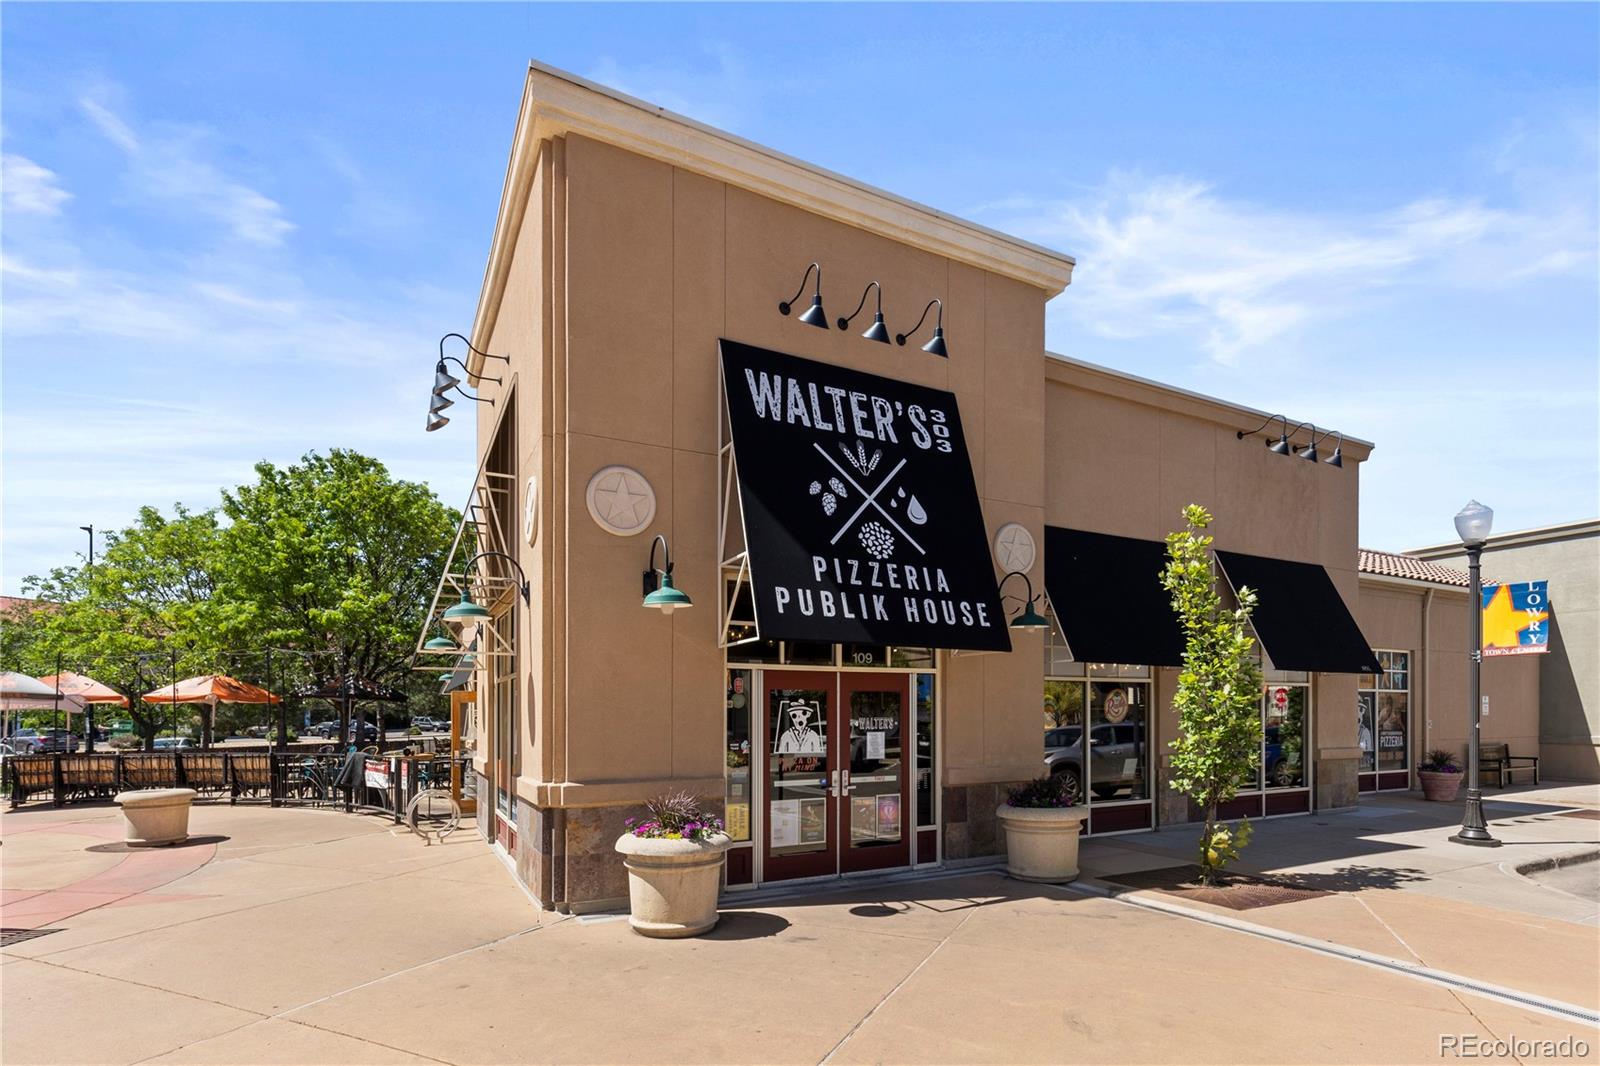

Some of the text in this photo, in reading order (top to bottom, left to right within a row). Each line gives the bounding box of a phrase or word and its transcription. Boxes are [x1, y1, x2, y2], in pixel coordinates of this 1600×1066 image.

[745, 368, 932, 450] WALTER'S
[930, 409, 953, 453] 303
[812, 555, 950, 593] PIZZERIA
[775, 586, 991, 628] PUBLIK HOUSE
[1525, 581, 1544, 645] LOWRY
[852, 652, 873, 664] 109
[1380, 735, 1403, 748] PIZZERIA
